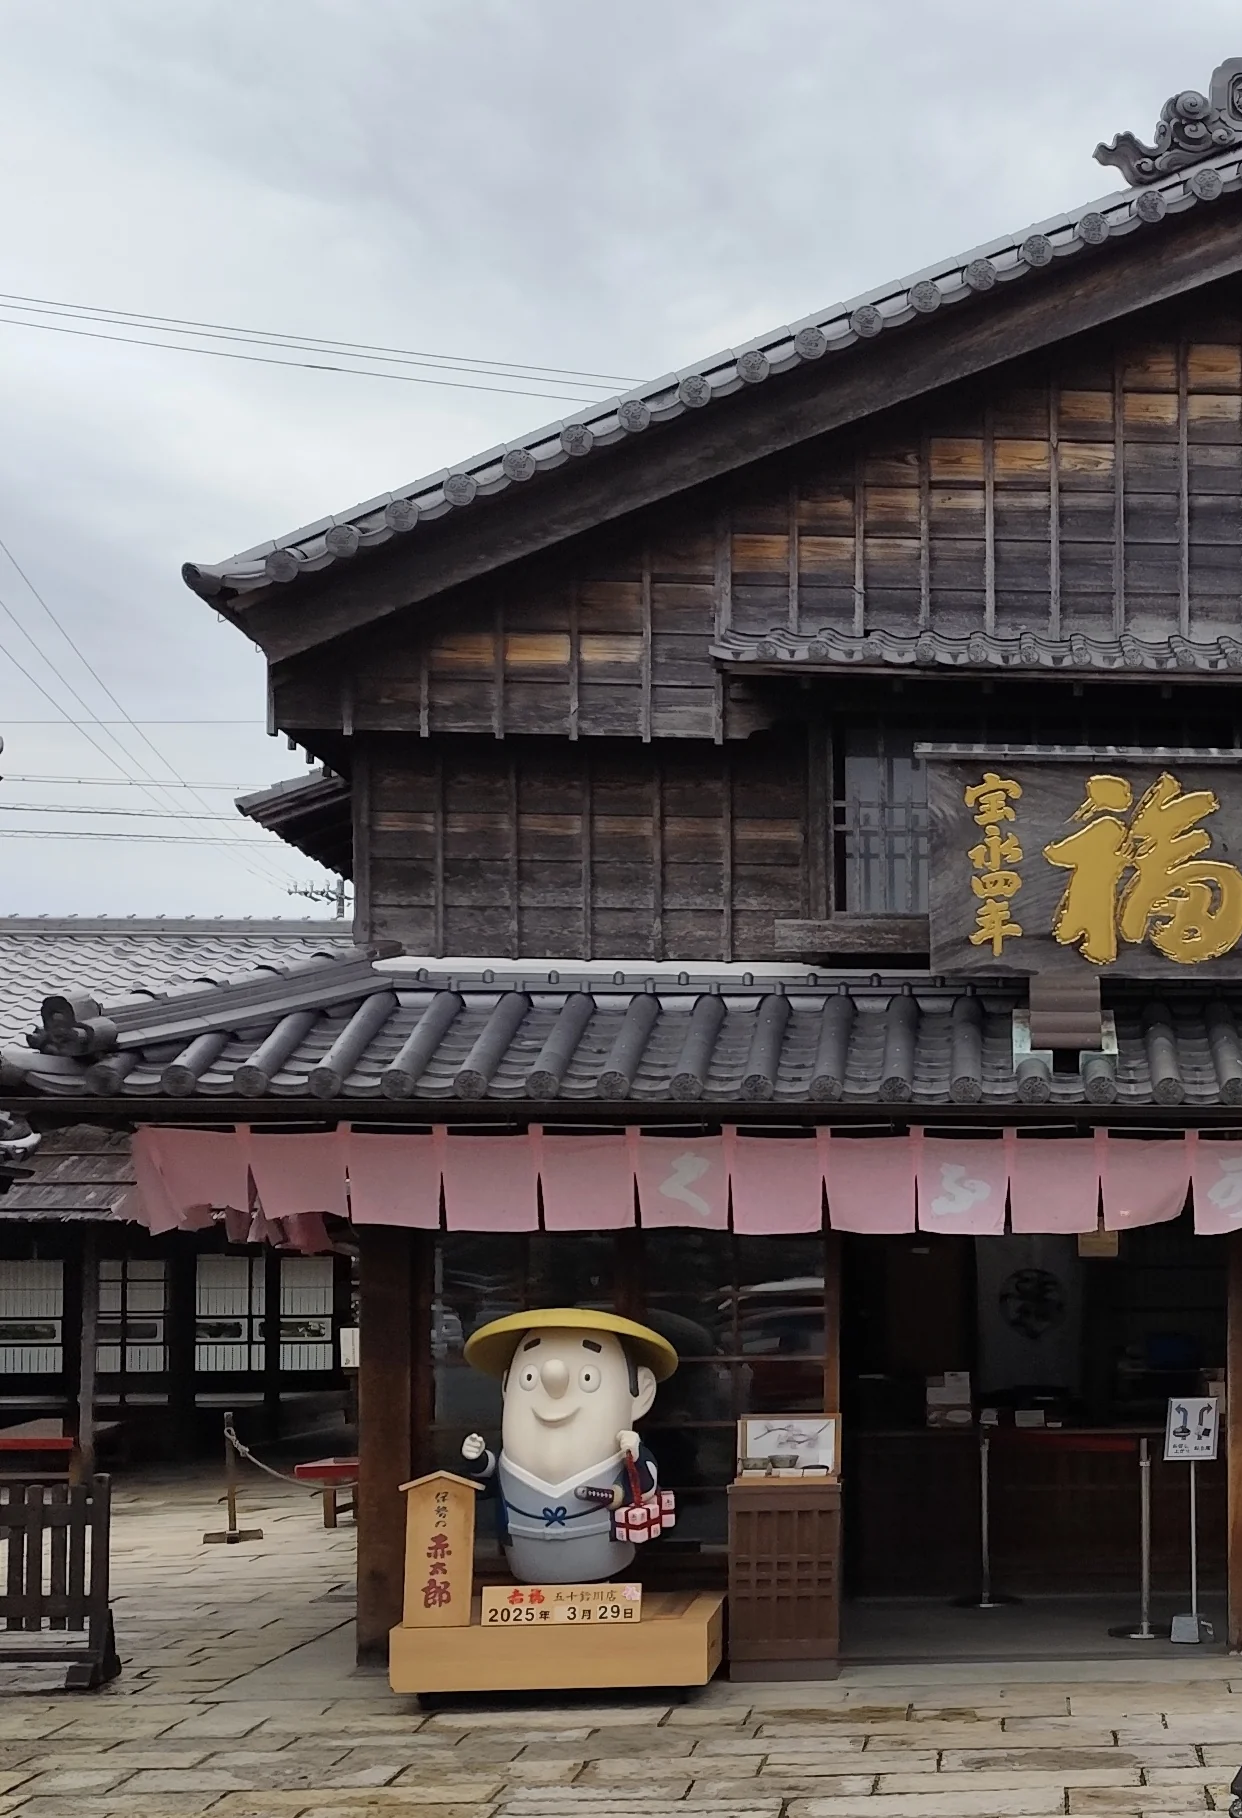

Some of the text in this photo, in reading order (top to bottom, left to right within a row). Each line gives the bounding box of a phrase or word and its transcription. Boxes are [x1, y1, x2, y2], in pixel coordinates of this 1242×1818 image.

[964, 772, 1023, 957] 宝永四年
[421, 1491, 452, 1609] 伊勢の 赤太郎
[488, 1604, 633, 1623] 2025年 3月 29日
[553, 1589, 617, 1603] 五十鈴川店
